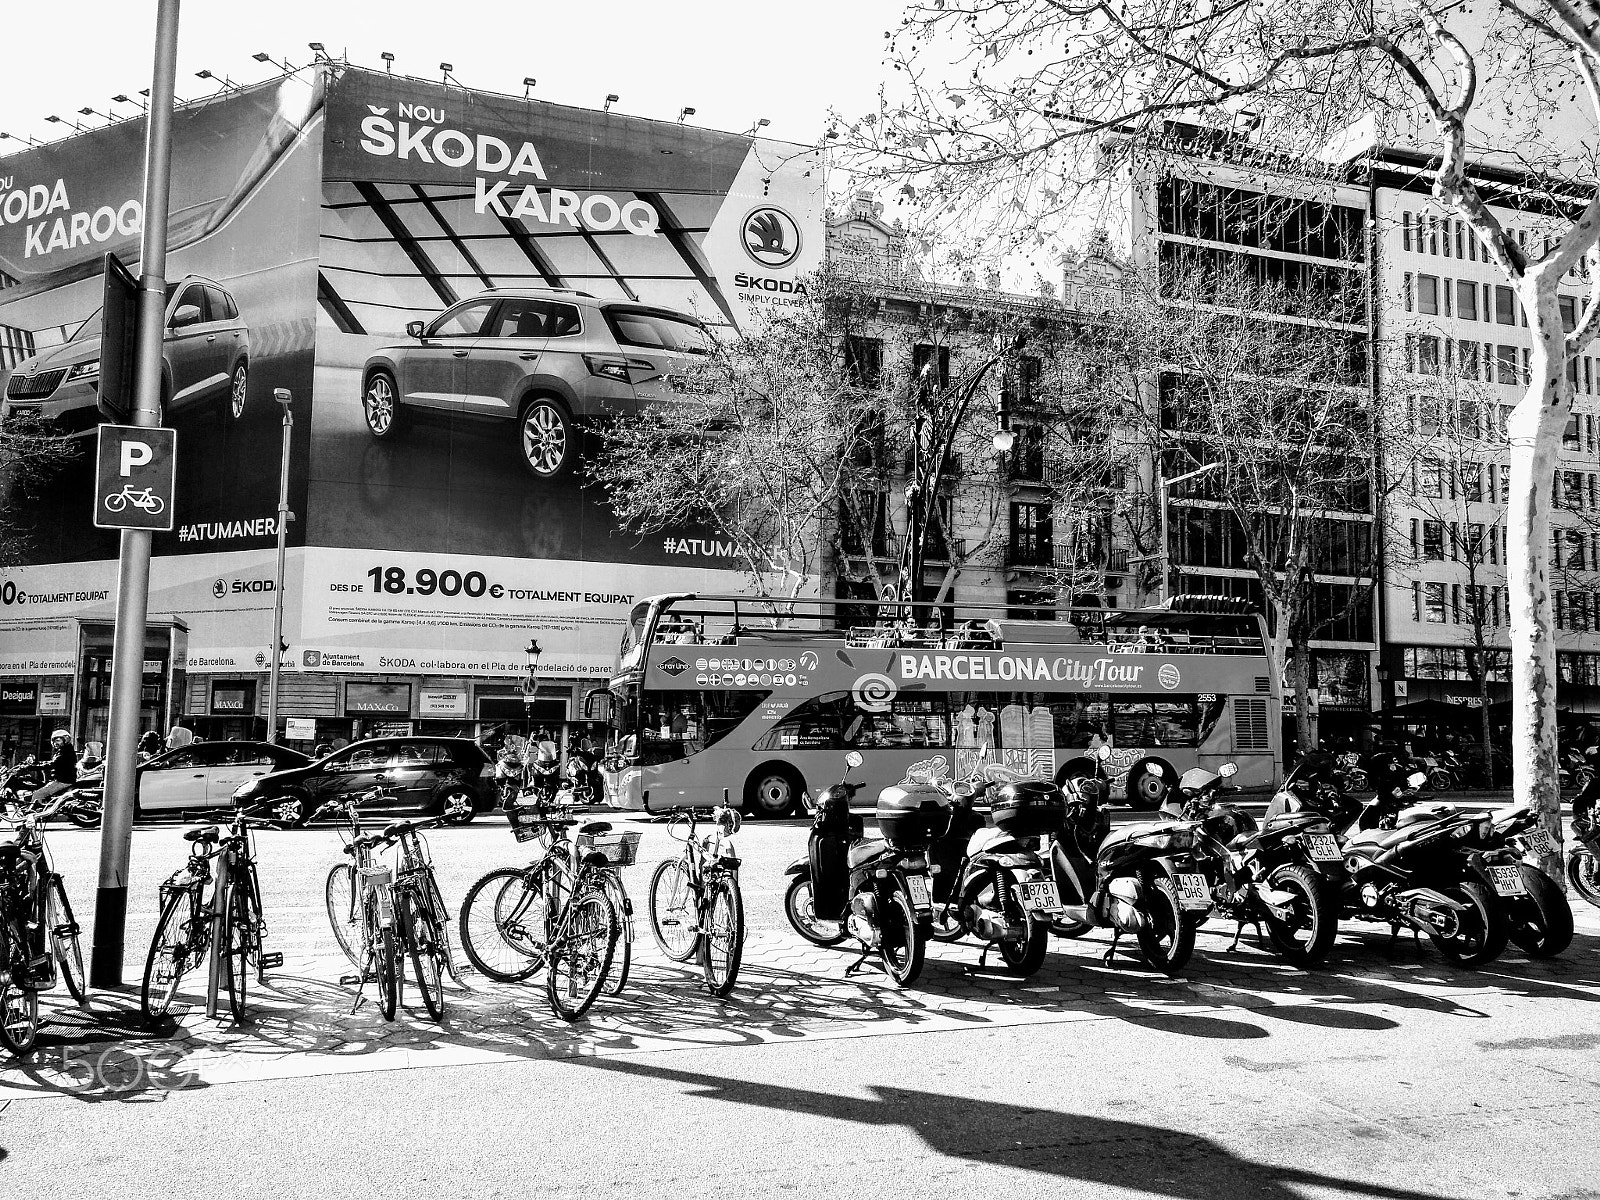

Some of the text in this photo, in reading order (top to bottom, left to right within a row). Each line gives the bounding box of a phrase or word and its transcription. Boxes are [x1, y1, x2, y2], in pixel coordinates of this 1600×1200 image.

[398, 102, 445, 124] NOU
[360, 104, 548, 181] ŠKODA
[474, 177, 660, 238] KAROQ
[24, 199, 144, 258] KAROQ
[734, 271, 808, 296] ŠKODA
[738, 292, 769, 304] SIMPLY
[120, 440, 153, 477] P
[28, 592, 73, 604] TOTALMENT
[75, 590, 109, 602] EQUIPAT
[330, 583, 349, 592] DES
[350, 584, 363, 593] DE
[508, 589, 581, 603] TOTALMENT
[584, 592, 635, 605] EQUIPAT
[188, 657, 198, 667] de
[322, 653, 360, 661] Ajuntament
[379, 656, 416, 668] ŠKODA
[481, 662, 490, 671] el
[492, 662, 506, 672] Pla
[508, 663, 519, 672] de
[576, 666, 588, 674] de
[589, 666, 612, 676] paret
[901, 655, 1051, 681] BARCELONA
[1198, 694, 1216, 702] 2553
[1312, 836, 1334, 846] 2324
[1316, 846, 1334, 856] GLH
[1496, 866, 1519, 879] 5935
[1182, 875, 1206, 886] 4131
[1499, 878, 1518, 890] HHY
[1029, 883, 1055, 896] 8781
[1184, 888, 1204, 898] DHS
[1034, 896, 1056, 908] GJR
